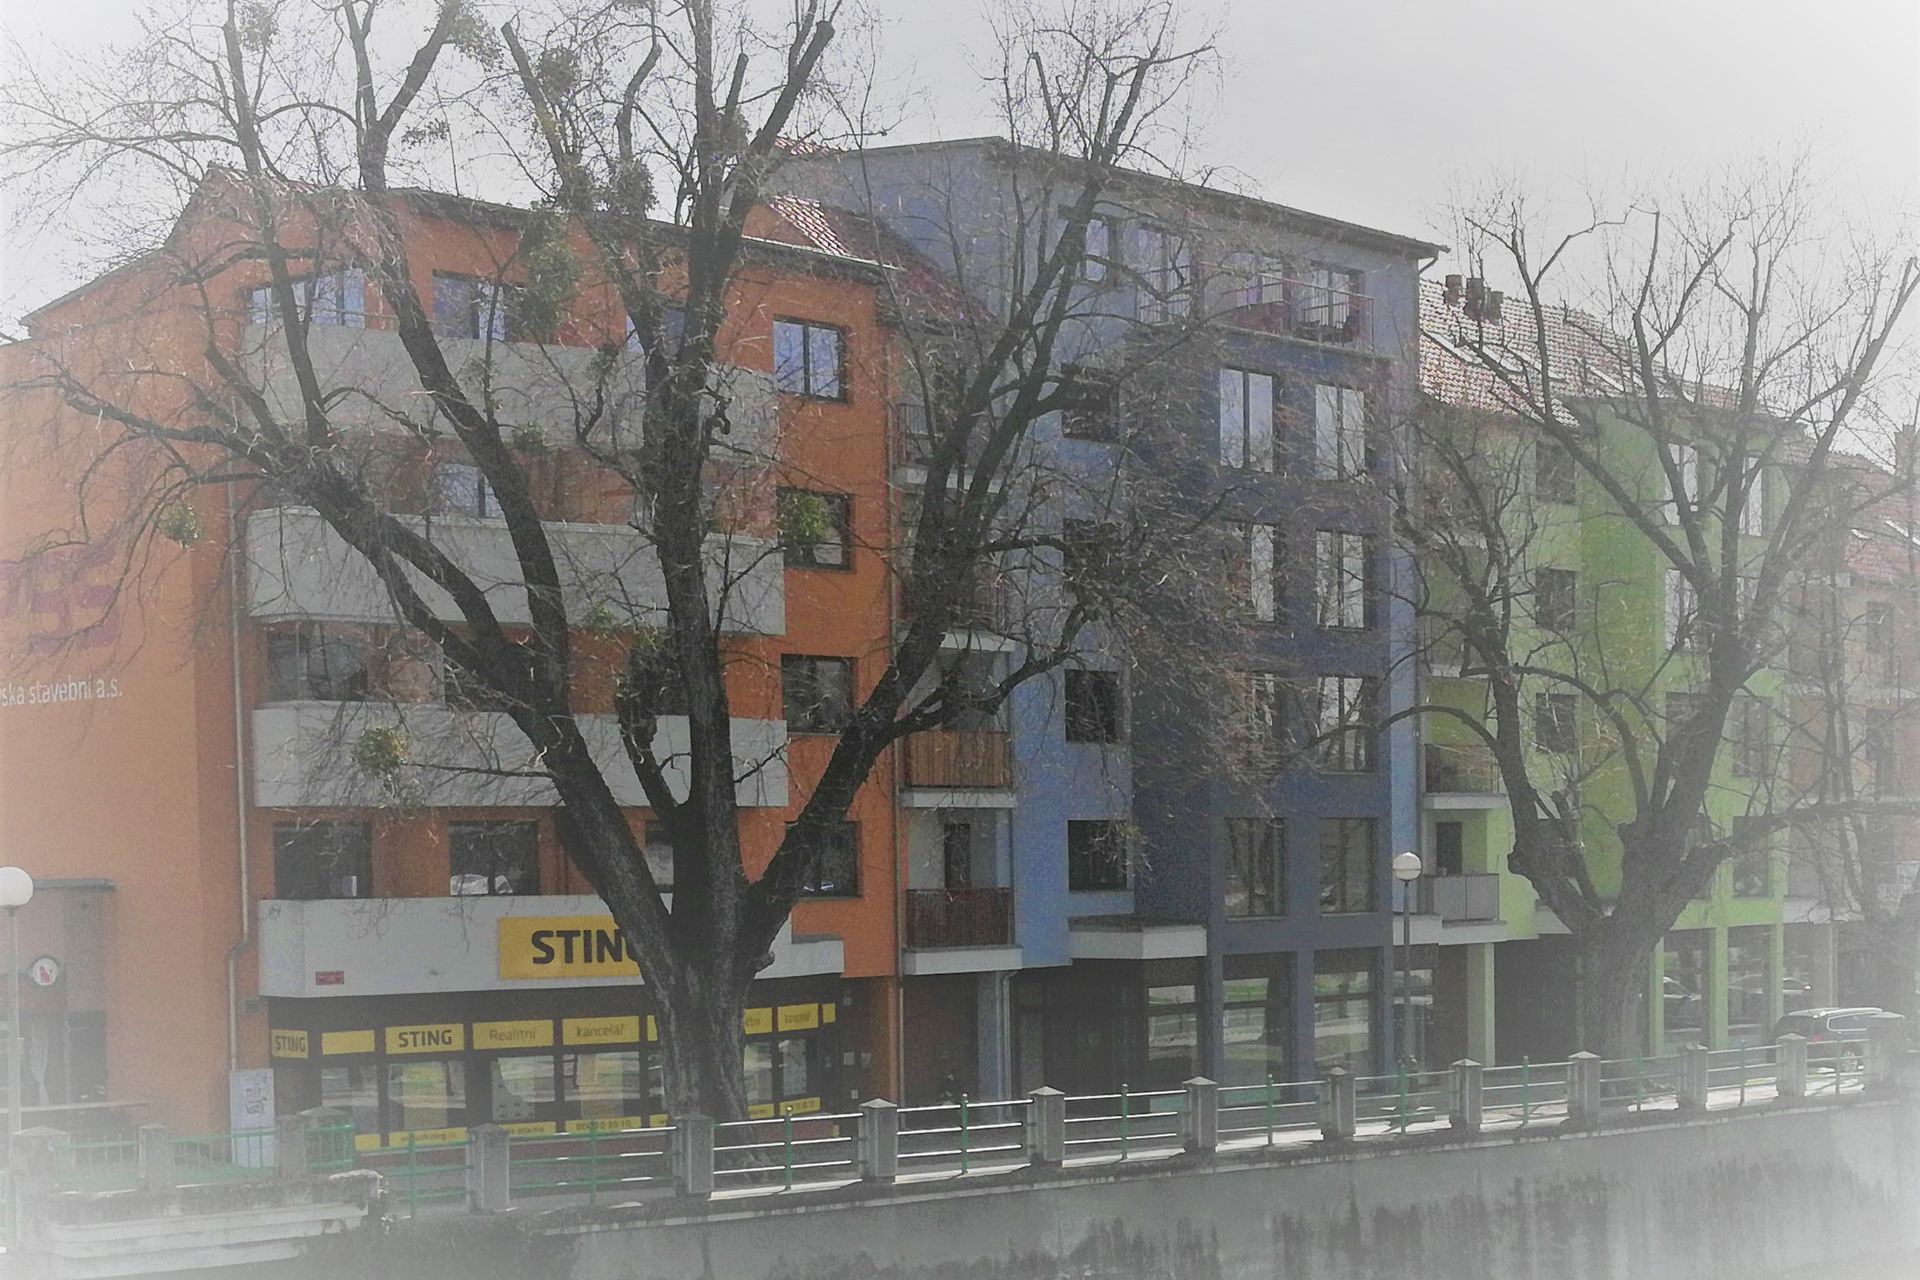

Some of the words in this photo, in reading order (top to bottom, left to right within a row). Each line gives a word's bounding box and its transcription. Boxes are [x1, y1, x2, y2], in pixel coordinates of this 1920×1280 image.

[97, 678, 123, 699] a.s.
[531, 929, 635, 964] STIN
[275, 1035, 306, 1053] STING
[398, 1029, 453, 1048] STING
